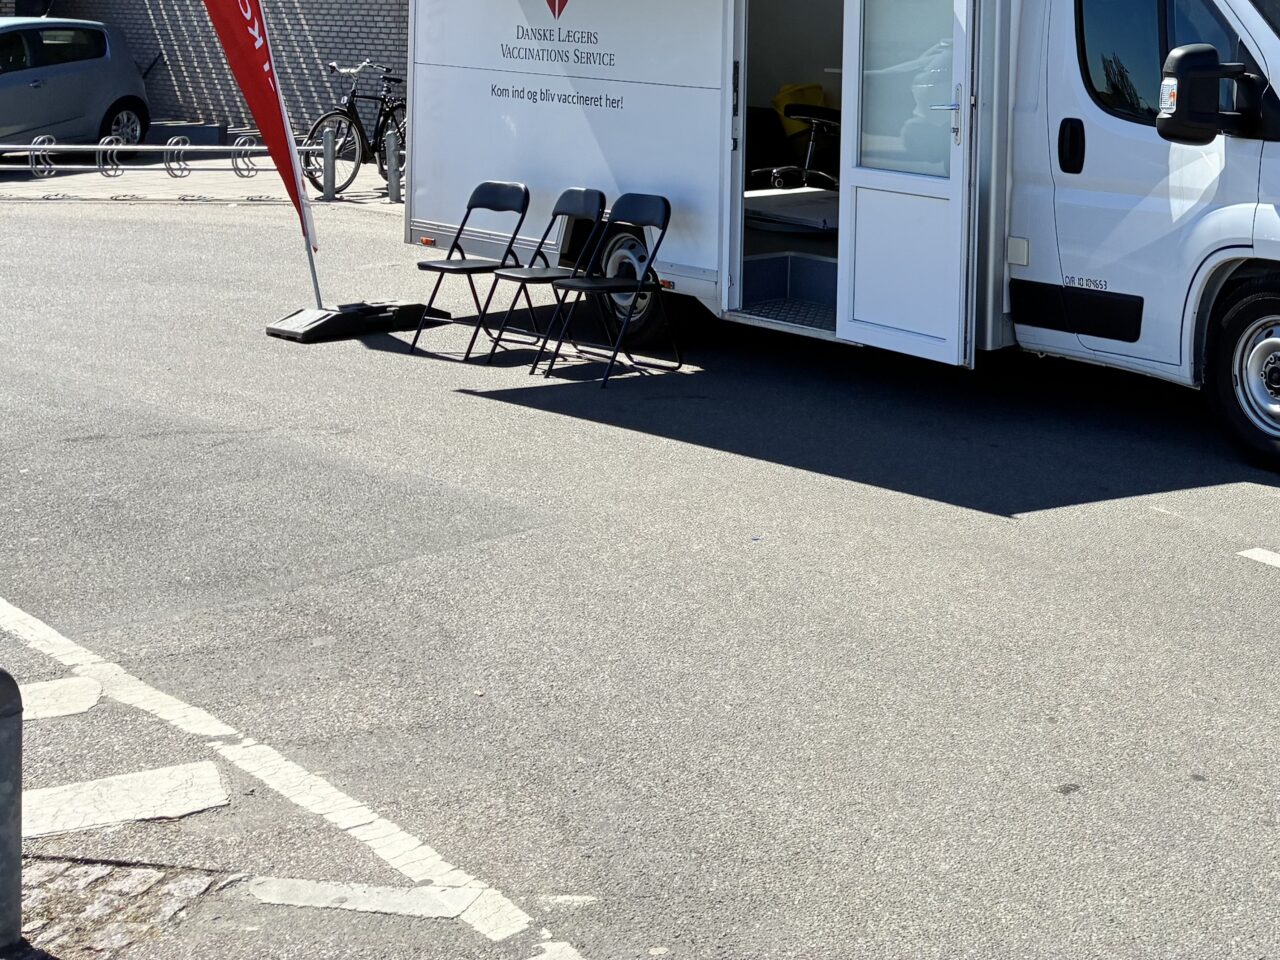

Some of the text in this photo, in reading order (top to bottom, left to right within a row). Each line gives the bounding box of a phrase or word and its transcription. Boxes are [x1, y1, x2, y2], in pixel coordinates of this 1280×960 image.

[516, 25, 599, 44] DANSKE LÆGERS
[500, 44, 615, 66] VACCINATIONS SERVICE
[491, 84, 624, 109] Kom ind og bliv vaccineret her!
